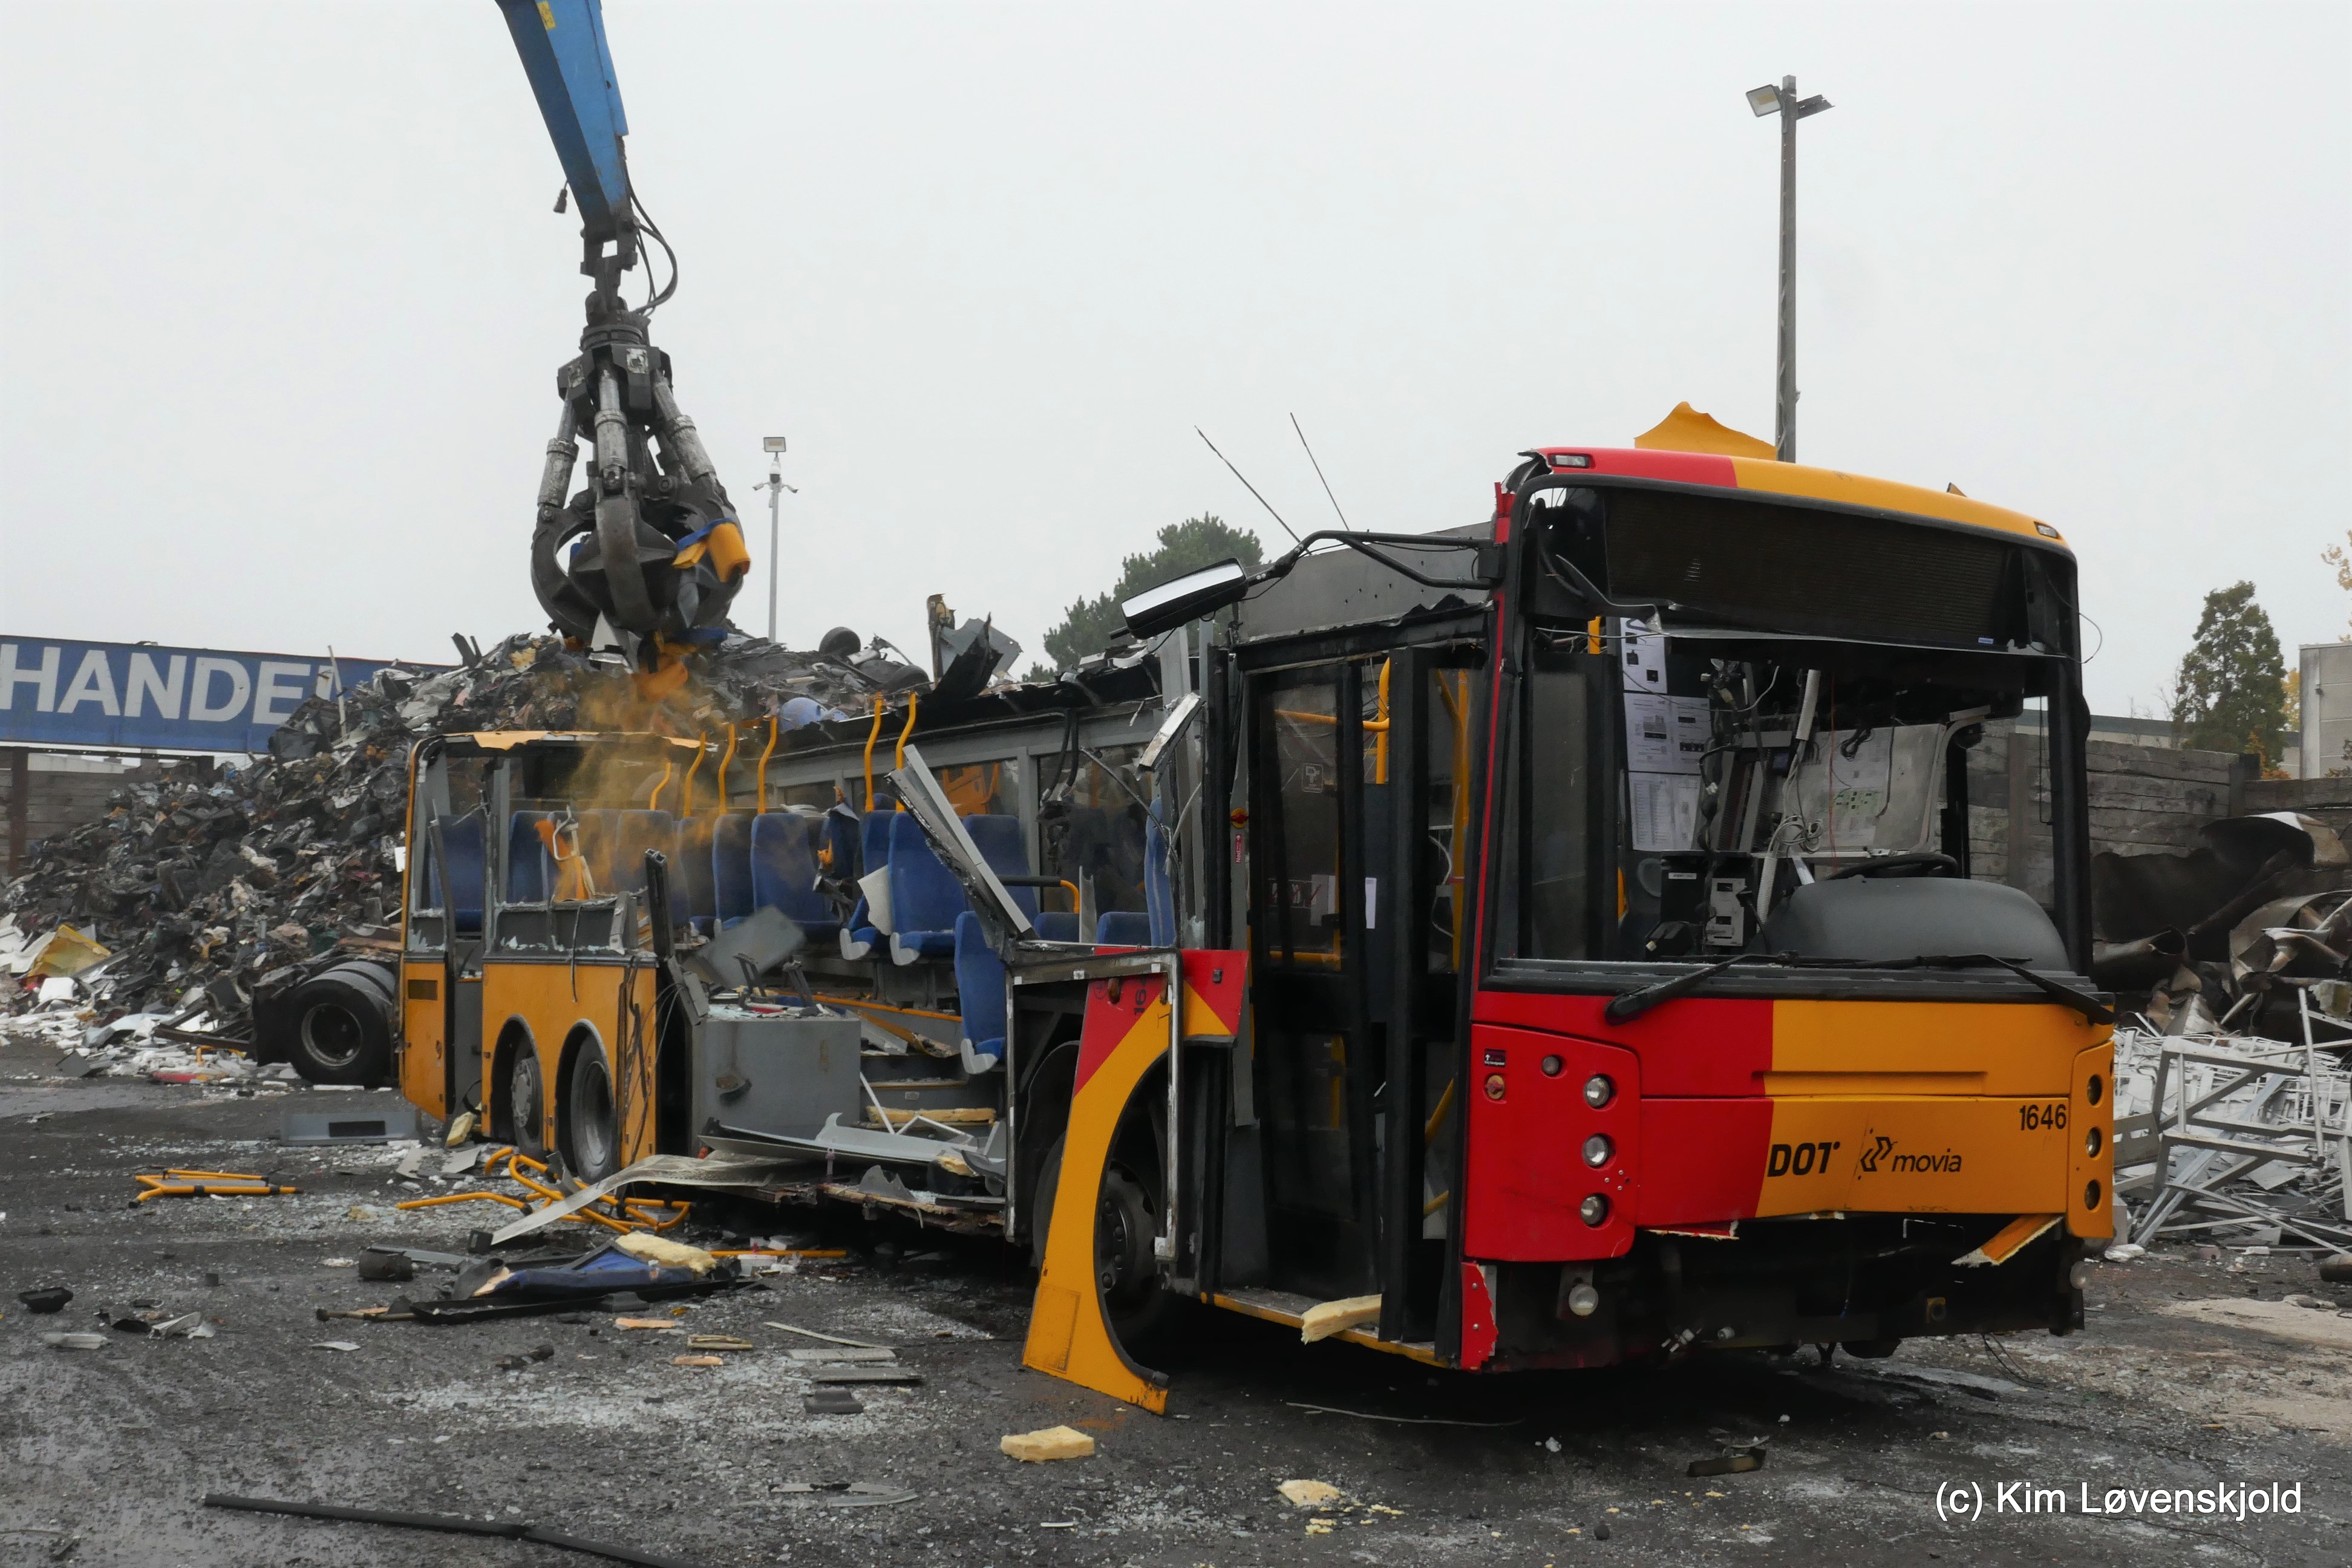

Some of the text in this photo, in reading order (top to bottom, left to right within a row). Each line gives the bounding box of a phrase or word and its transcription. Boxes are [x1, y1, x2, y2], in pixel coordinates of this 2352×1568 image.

[2019, 1104, 2066, 1131] 1646
[1766, 1142, 1833, 1178] DOT
[1891, 1148, 1962, 1173] movia
